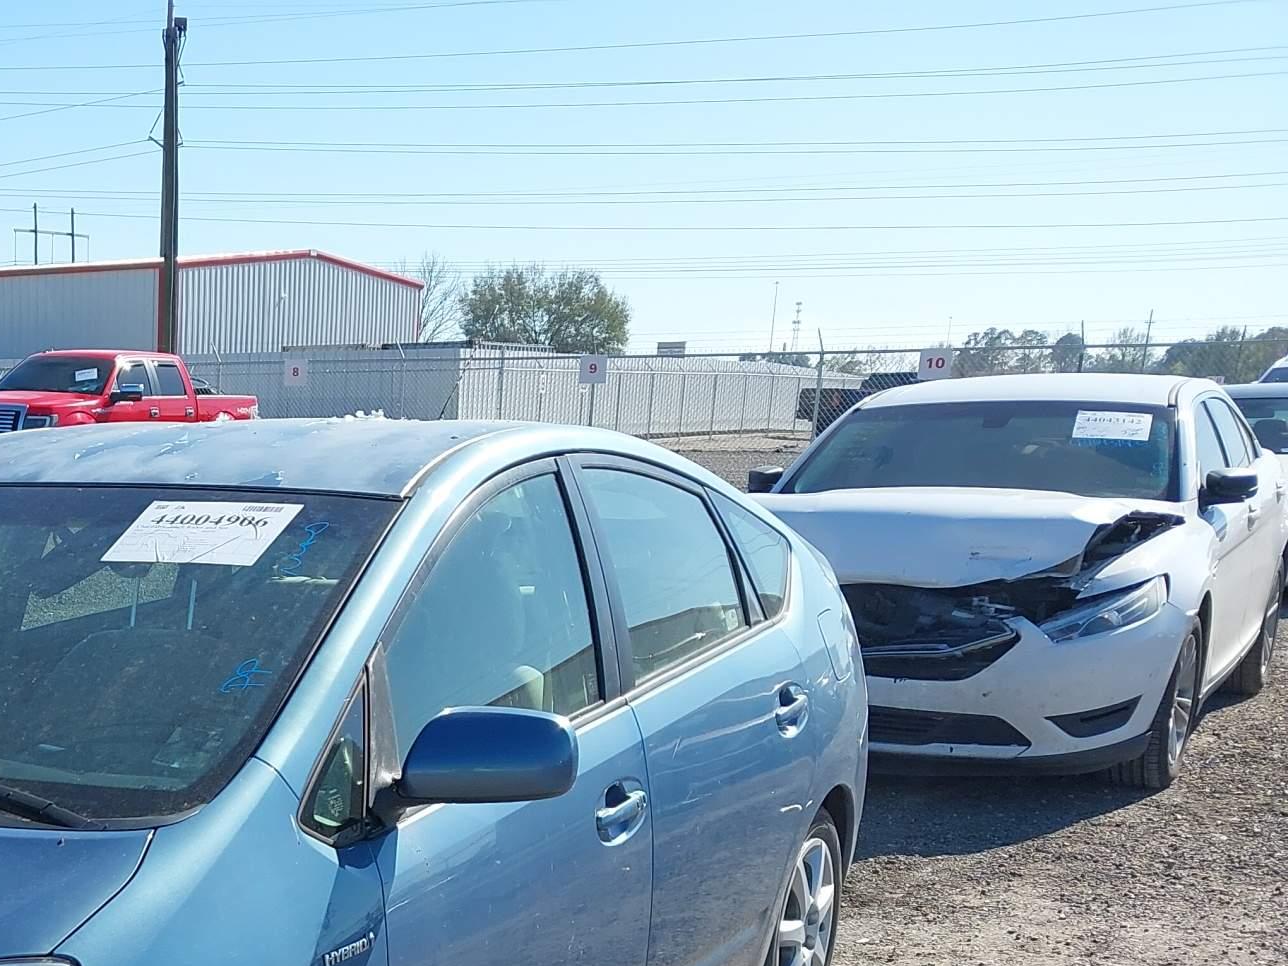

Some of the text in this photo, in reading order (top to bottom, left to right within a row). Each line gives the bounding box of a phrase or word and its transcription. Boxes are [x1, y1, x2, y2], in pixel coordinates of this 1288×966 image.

[588, 363, 598, 374] 9
[926, 357, 946, 369] 10
[292, 367, 299, 377] 8
